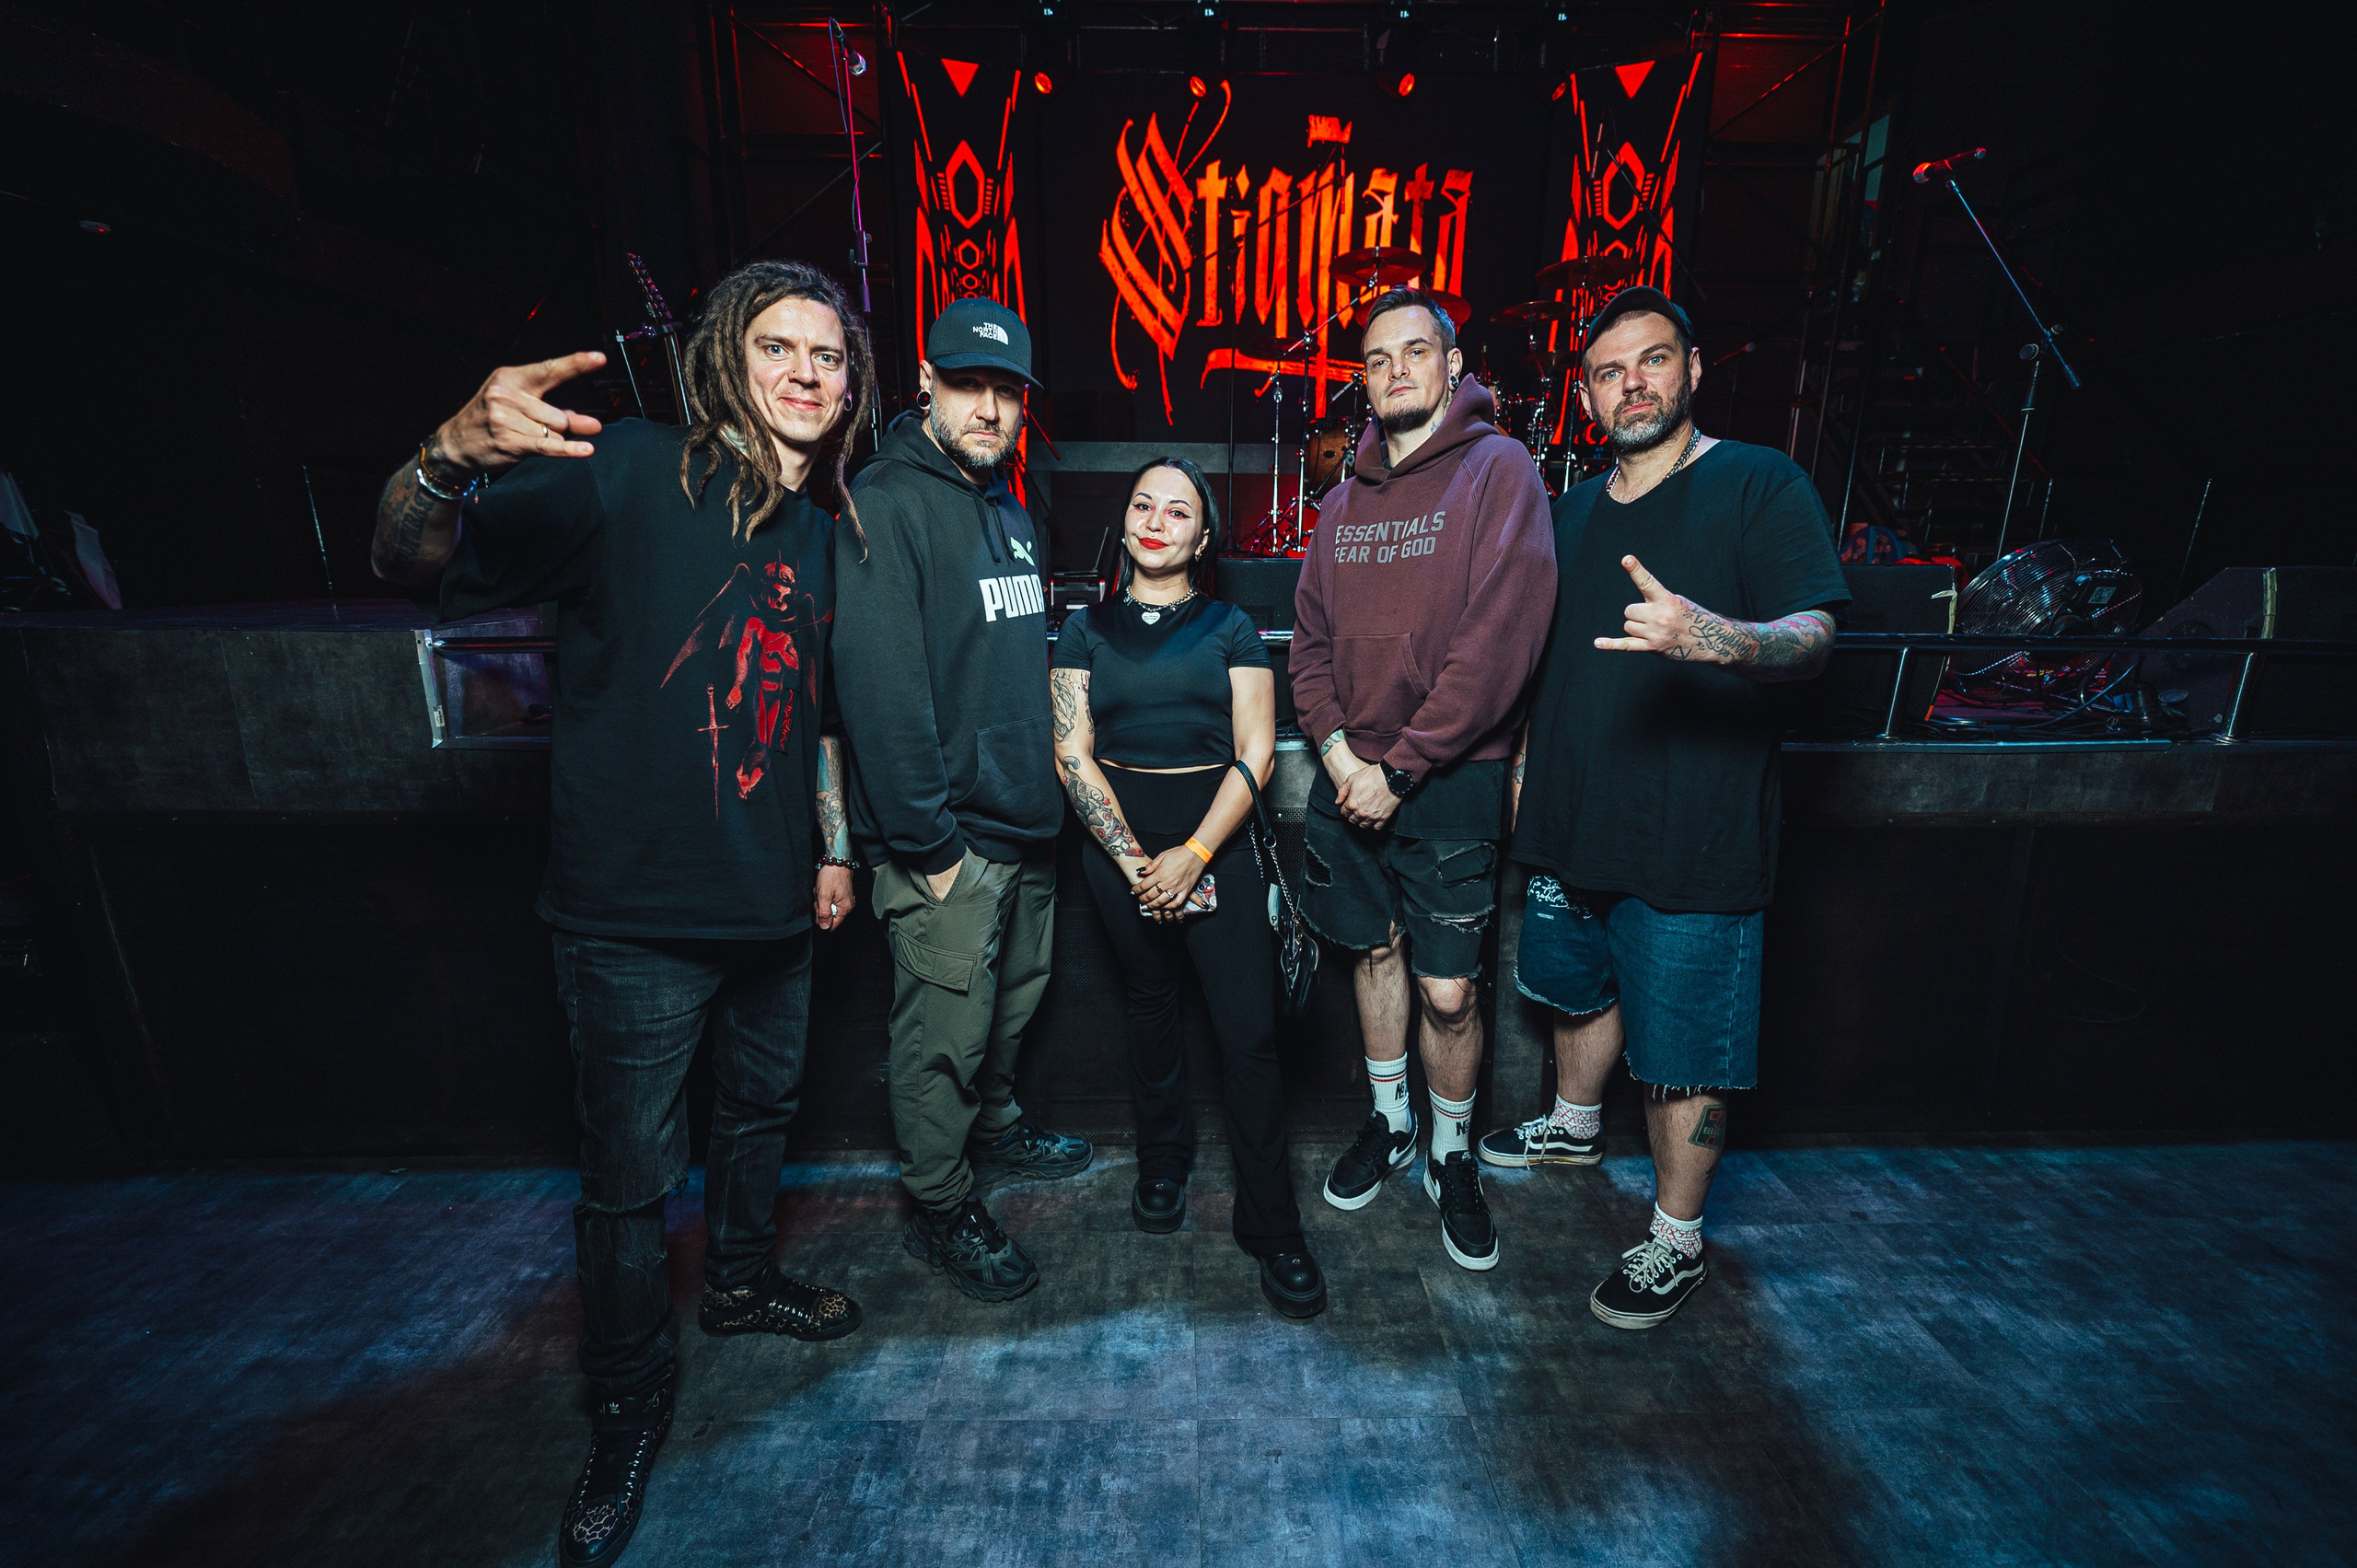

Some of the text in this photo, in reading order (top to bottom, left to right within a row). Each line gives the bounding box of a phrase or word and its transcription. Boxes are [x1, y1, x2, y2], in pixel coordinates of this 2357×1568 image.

[980, 332, 998, 341] FACE
[1335, 511, 1446, 545] ESSENTIALS
[1335, 536, 1436, 563] FEAR OF GOD
[979, 574, 1045, 622] PUMA
